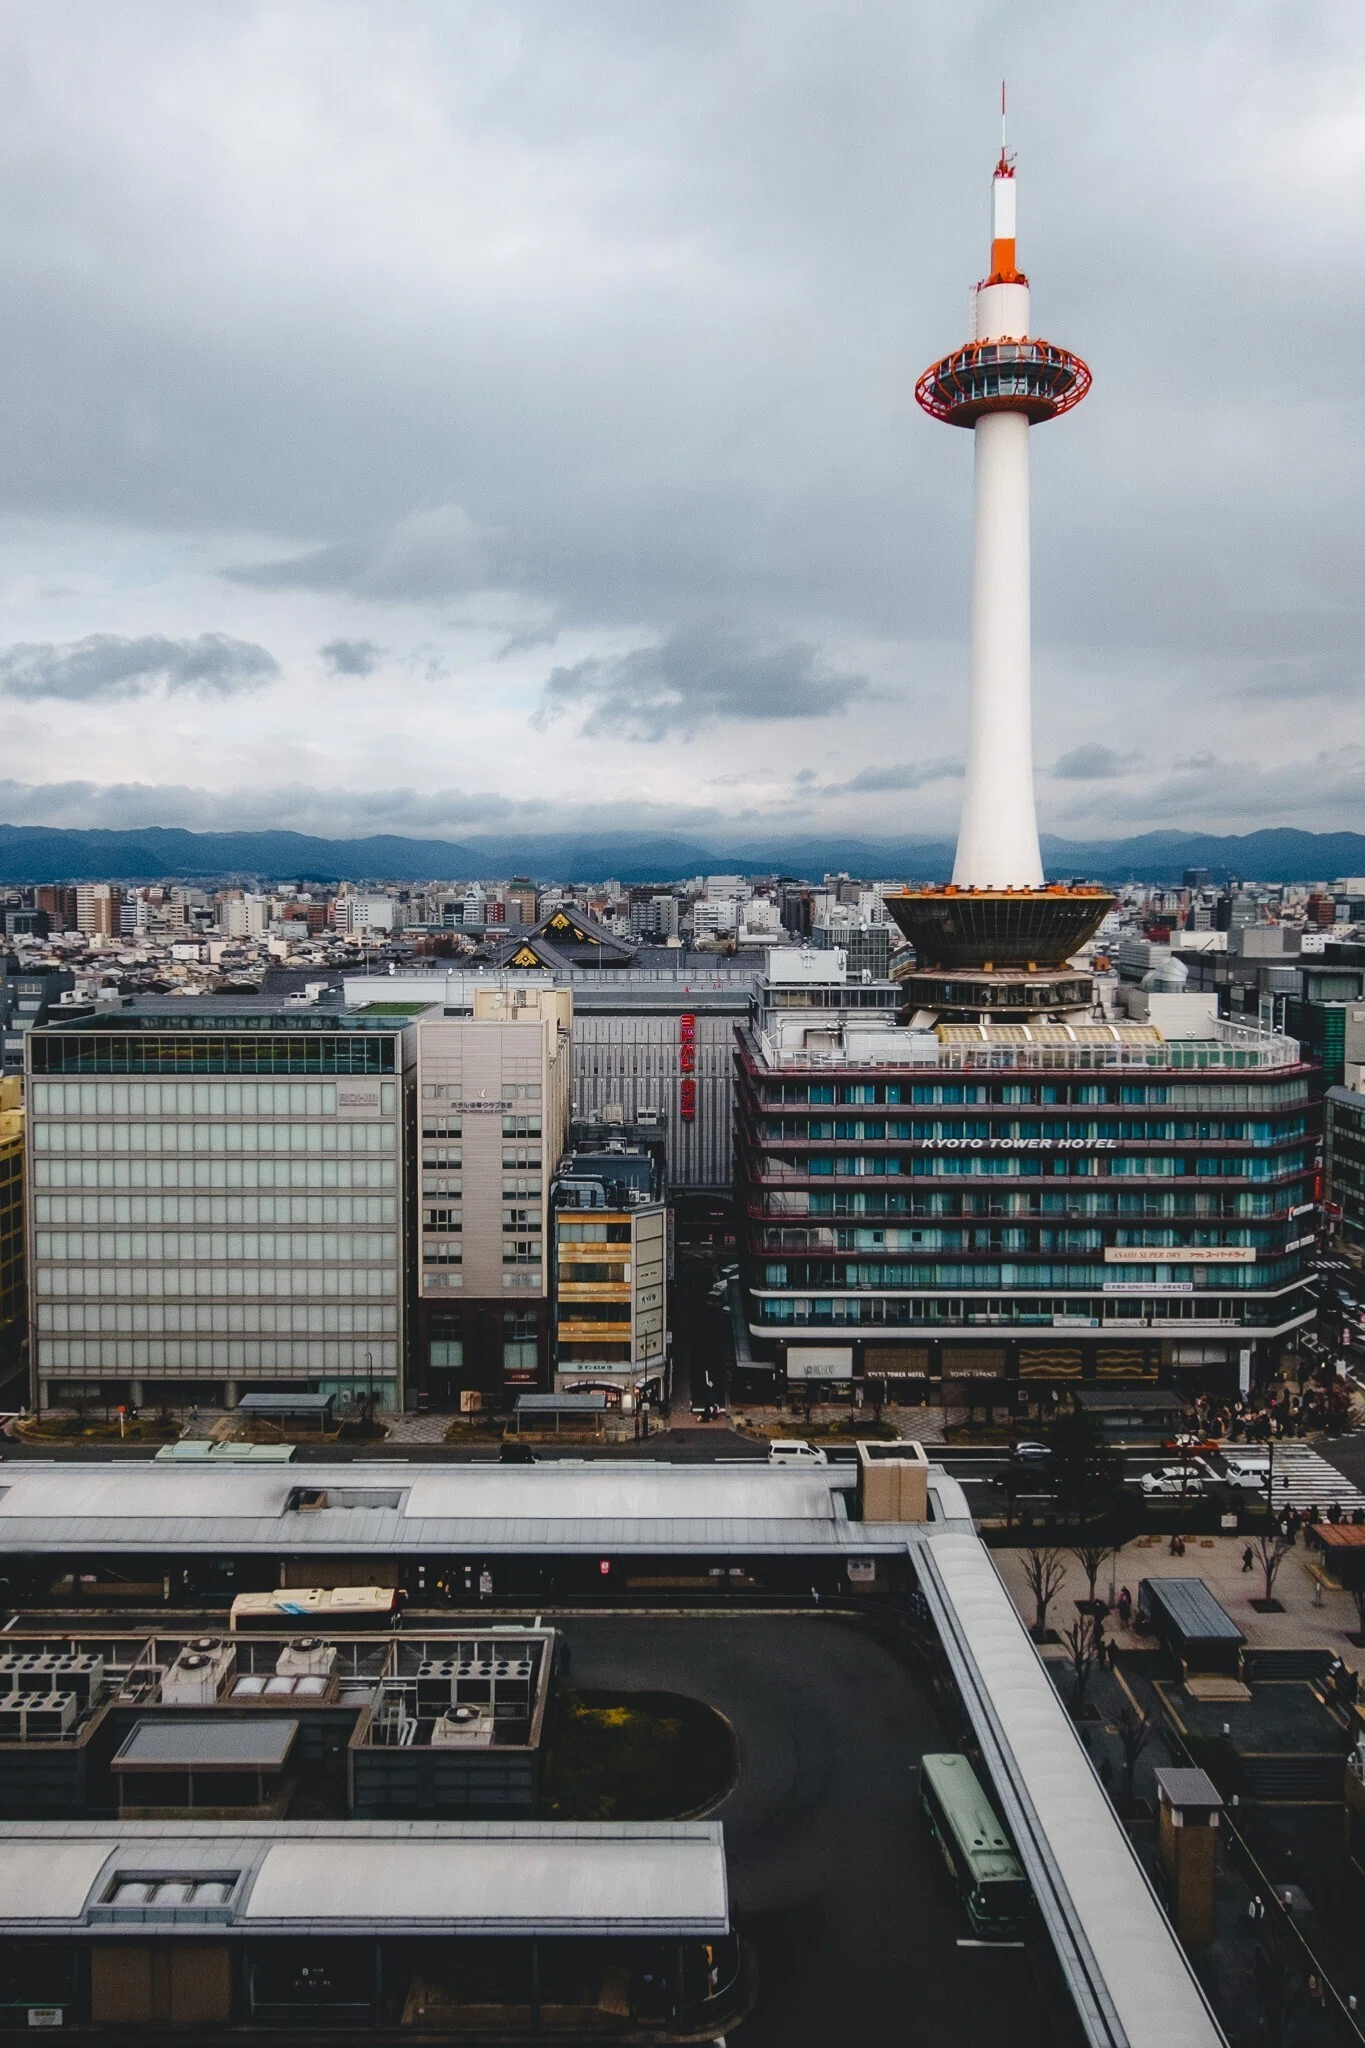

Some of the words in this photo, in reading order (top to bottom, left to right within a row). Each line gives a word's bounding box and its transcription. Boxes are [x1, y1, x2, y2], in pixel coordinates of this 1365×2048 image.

[921, 1139, 983, 1149] KYOTO
[989, 1139, 1052, 1149] TOWER
[1057, 1139, 1117, 1149] HOTEL
[1139, 1251, 1165, 1259] SUPER
[1166, 1251, 1182, 1259] DRY
